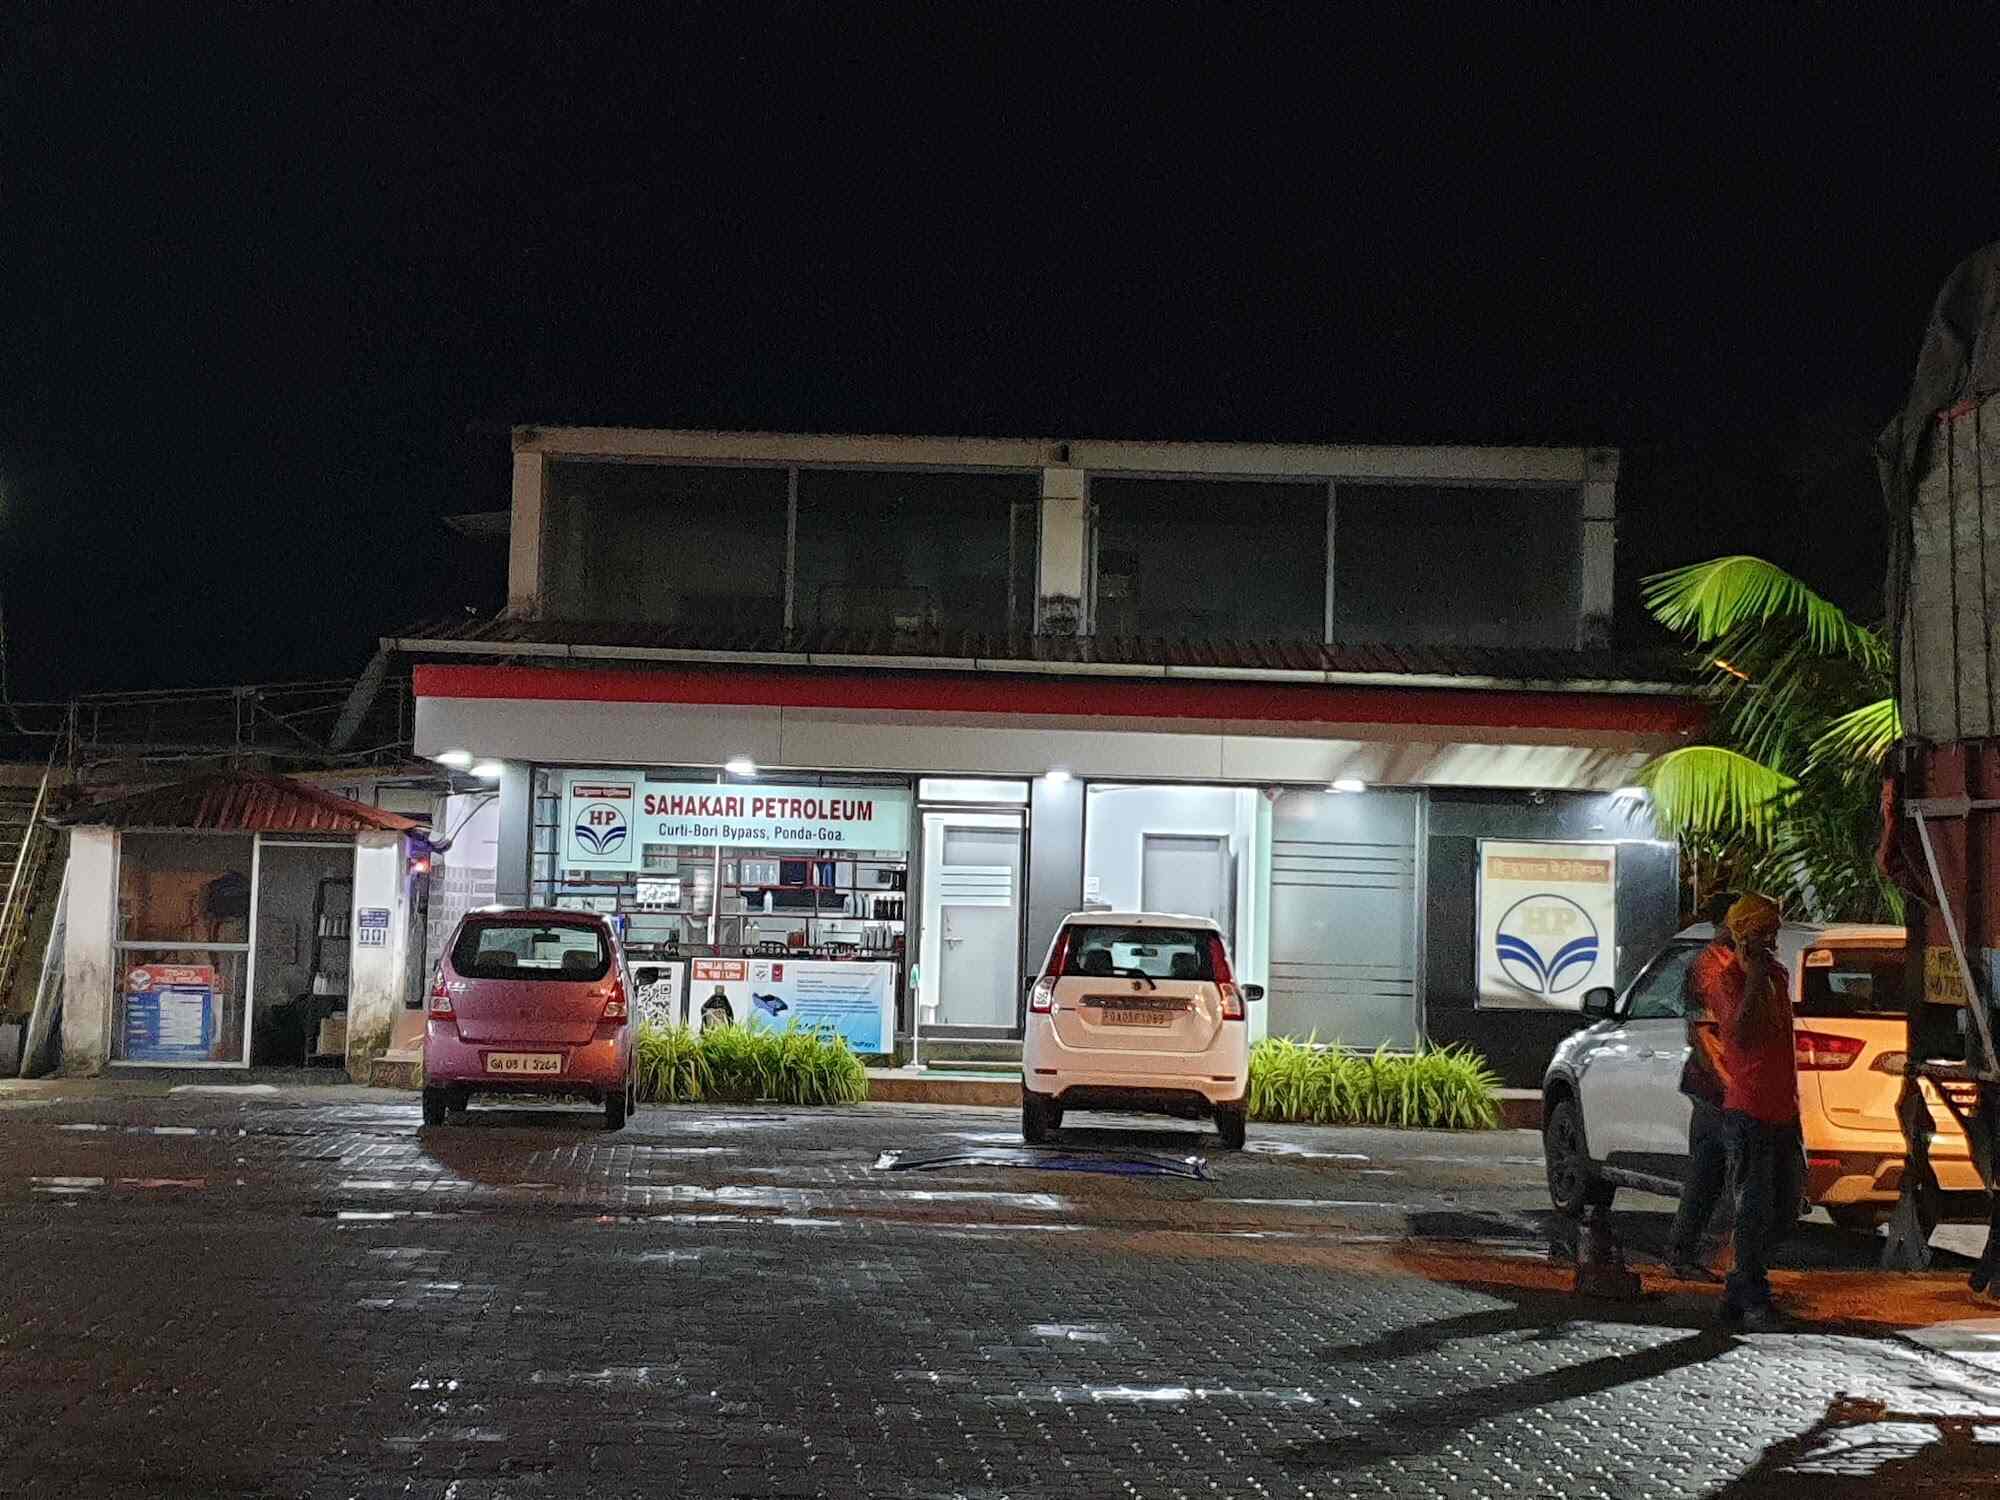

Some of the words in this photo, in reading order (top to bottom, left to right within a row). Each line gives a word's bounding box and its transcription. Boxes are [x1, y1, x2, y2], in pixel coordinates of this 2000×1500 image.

[589, 810, 617, 825] HP
[644, 794, 744, 817] SAHAKARI
[752, 798, 873, 821] PETROLEUM
[659, 823, 718, 837] Curti-Bori
[723, 825, 769, 841] Bypass,
[774, 826, 845, 841] Ponda-Goa.
[1521, 906, 1577, 935] HP
